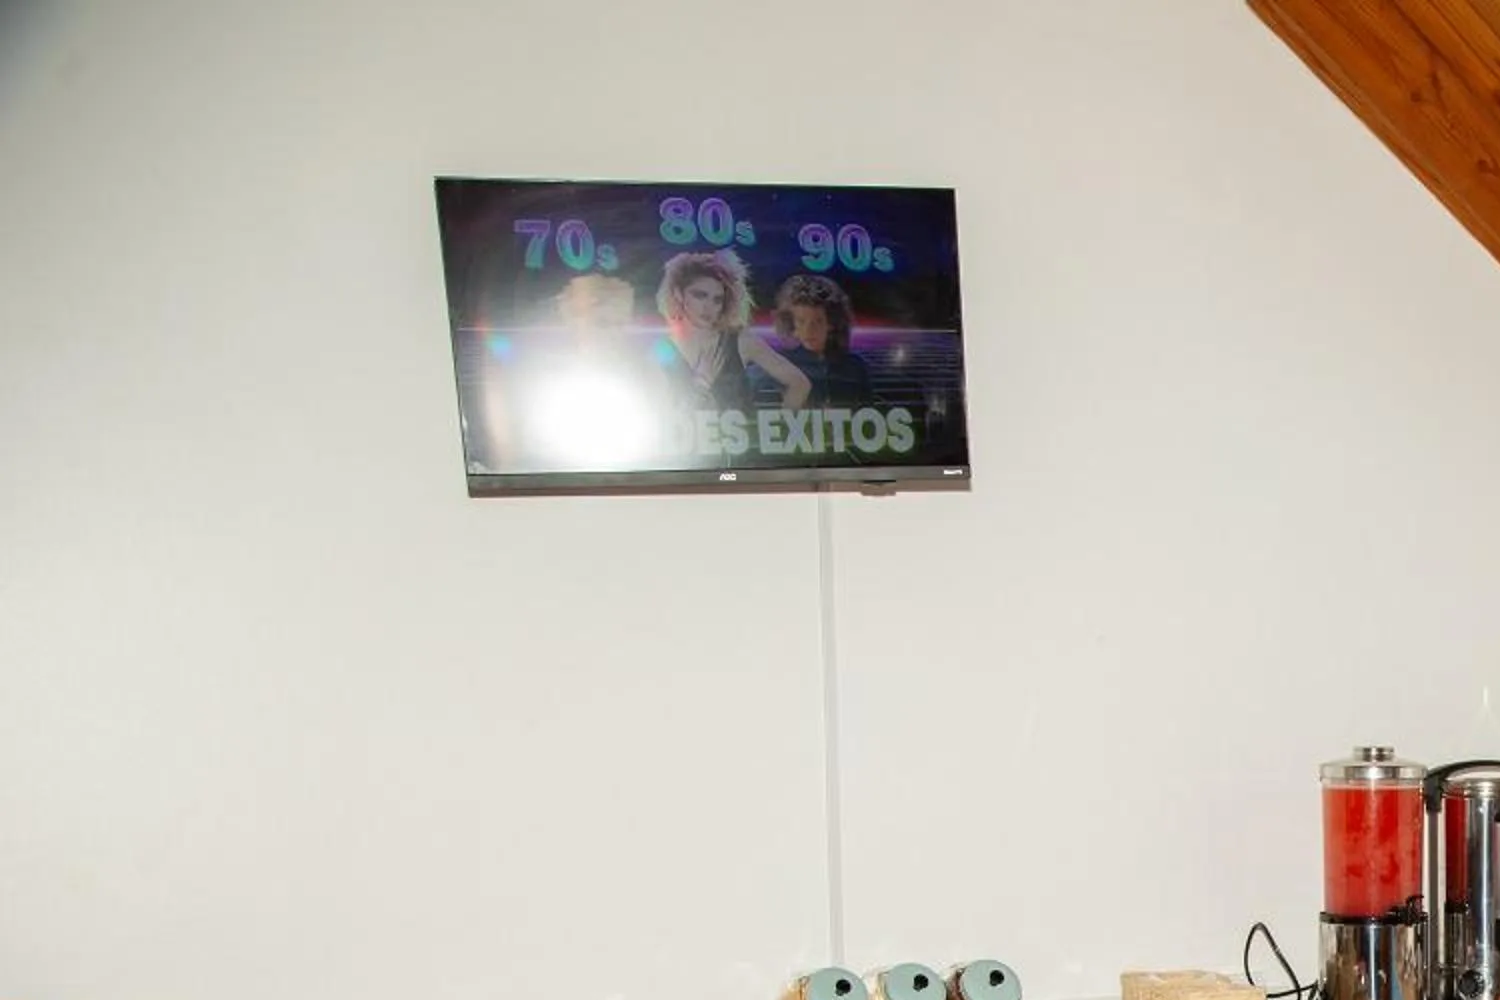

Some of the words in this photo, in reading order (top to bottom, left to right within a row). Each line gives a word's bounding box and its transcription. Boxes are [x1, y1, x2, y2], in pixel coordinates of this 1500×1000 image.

[514, 218, 620, 271] 70s
[659, 197, 756, 247] 80s
[798, 222, 895, 272] 90s
[757, 407, 916, 455] EXITOS
